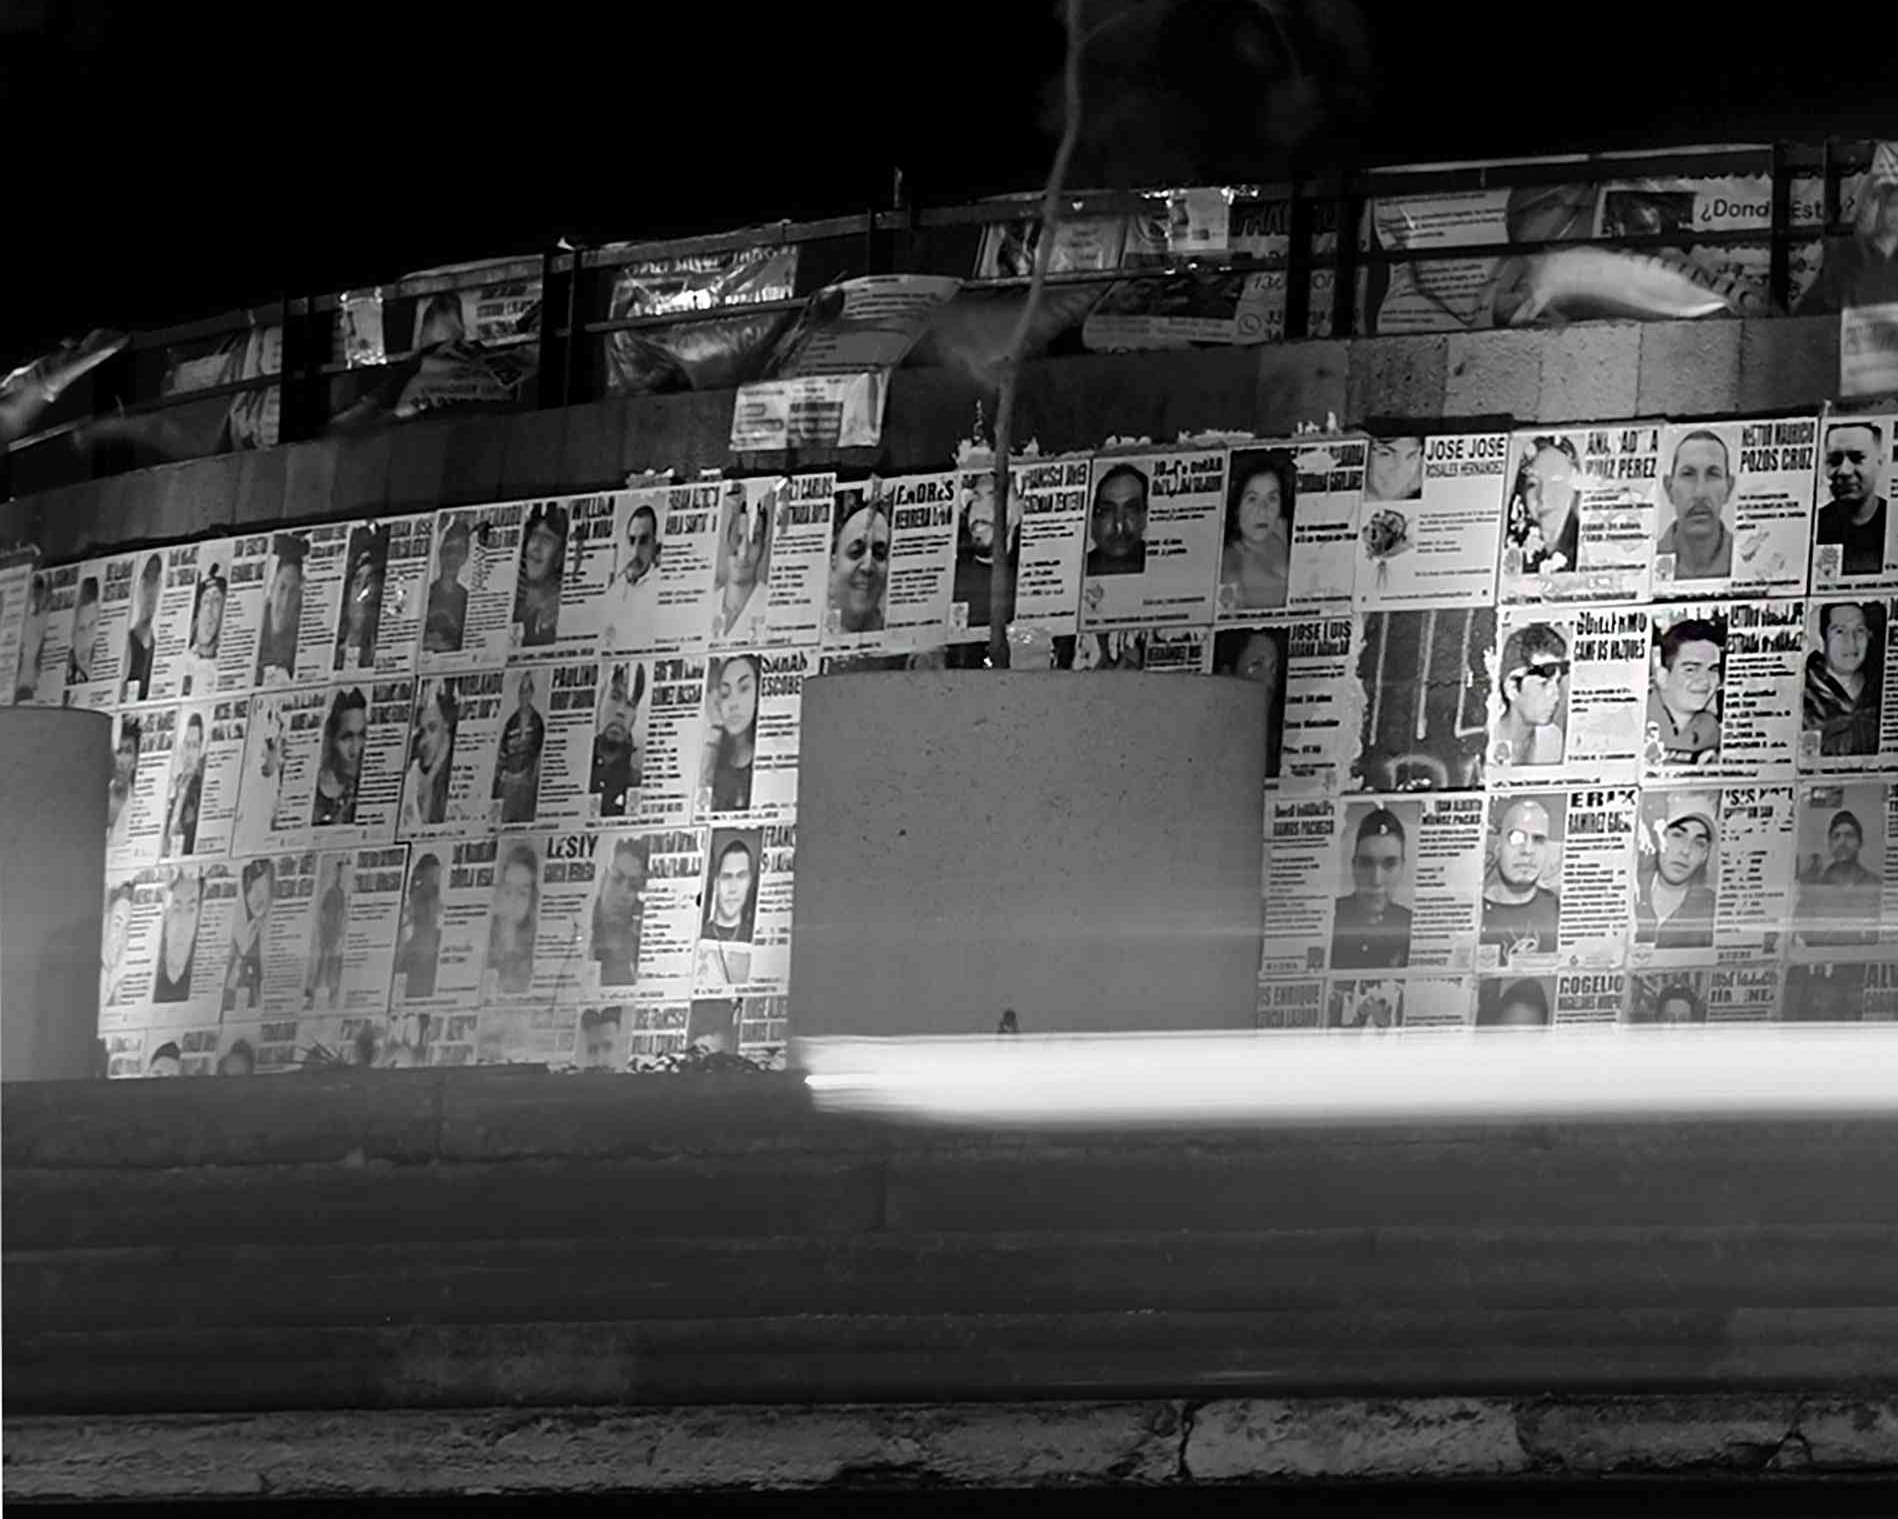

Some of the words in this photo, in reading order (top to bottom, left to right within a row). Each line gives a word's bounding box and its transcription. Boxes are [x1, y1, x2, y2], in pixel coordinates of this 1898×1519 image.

[1701, 198, 1771, 222] ¿Dond
[1791, 196, 1856, 219] Est?
[1740, 449, 1779, 473] POZOS
[1780, 447, 1814, 471] CRUZ
